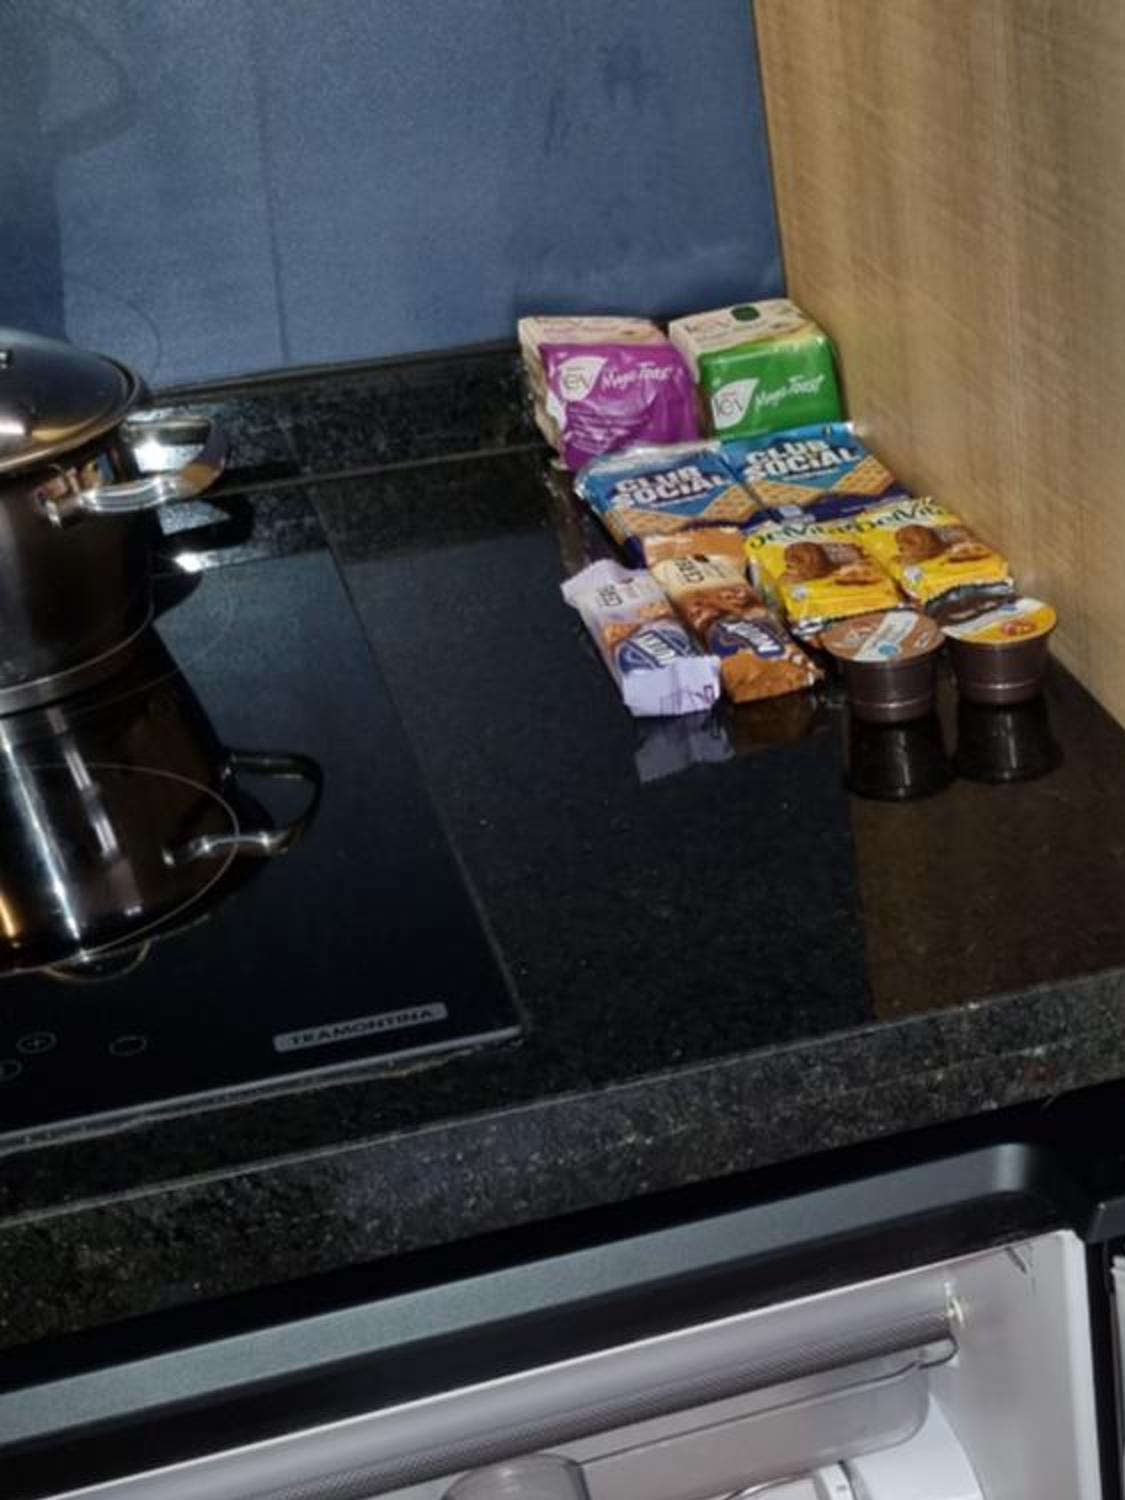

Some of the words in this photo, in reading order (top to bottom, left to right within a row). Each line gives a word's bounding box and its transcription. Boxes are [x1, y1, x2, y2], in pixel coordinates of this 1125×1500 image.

[744, 448, 863, 481] SOCIAL
[747, 439, 830, 465] CLUB
[609, 475, 731, 507] SOCIAL
[615, 464, 704, 492] CLUB
[290, 1007, 436, 1047] TRAMONTINA
